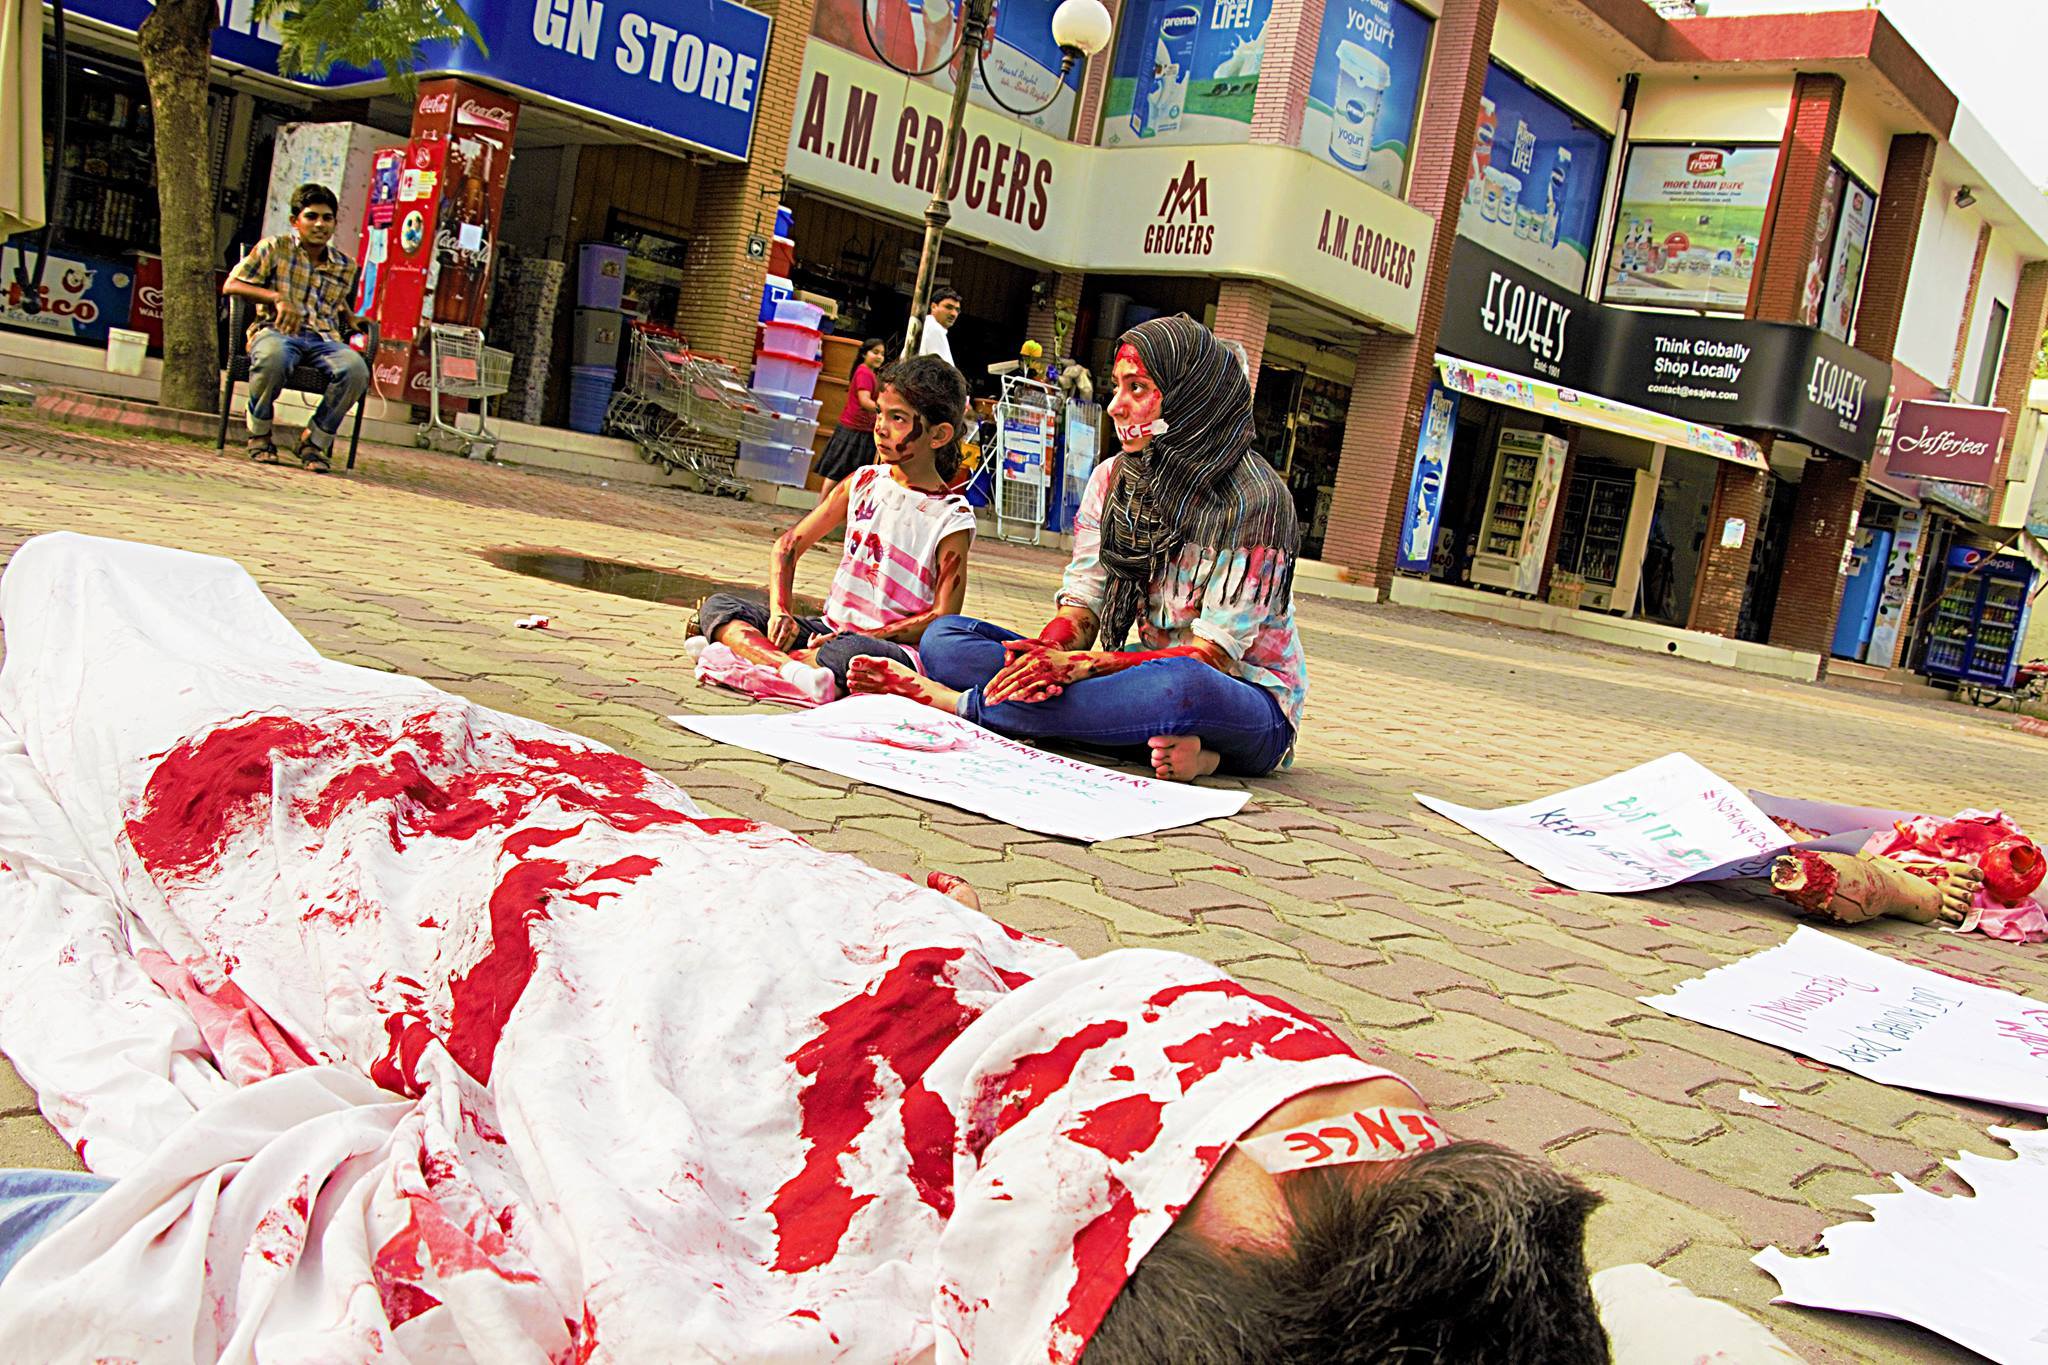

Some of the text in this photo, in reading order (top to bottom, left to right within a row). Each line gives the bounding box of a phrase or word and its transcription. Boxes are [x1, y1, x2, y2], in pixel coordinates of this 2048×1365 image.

[1163, 16, 1197, 30] prema
[1211, 0, 1253, 29] LIFE!
[1346, 7, 1395, 49] yogurt
[615, 13, 757, 112] STORE
[1338, 127, 1364, 146] yogurt
[798, 71, 1052, 231] A.M. GROCERS
[1689, 160, 1717, 171] fresh
[1663, 179, 1744, 191] more than pure
[1144, 224, 1215, 255] GROCERS
[1318, 209, 1416, 289] A.M. GROCERS
[1655, 337, 1750, 363] Think Globally
[1654, 357, 1741, 383] Shop Locally
[1648, 384, 1738, 400] contact@esajee.com
[1897, 425, 1989, 457] Jafferjees
[1530, 808, 1596, 836] KEEP
[1284, 1108, 1439, 1163] ENCE
